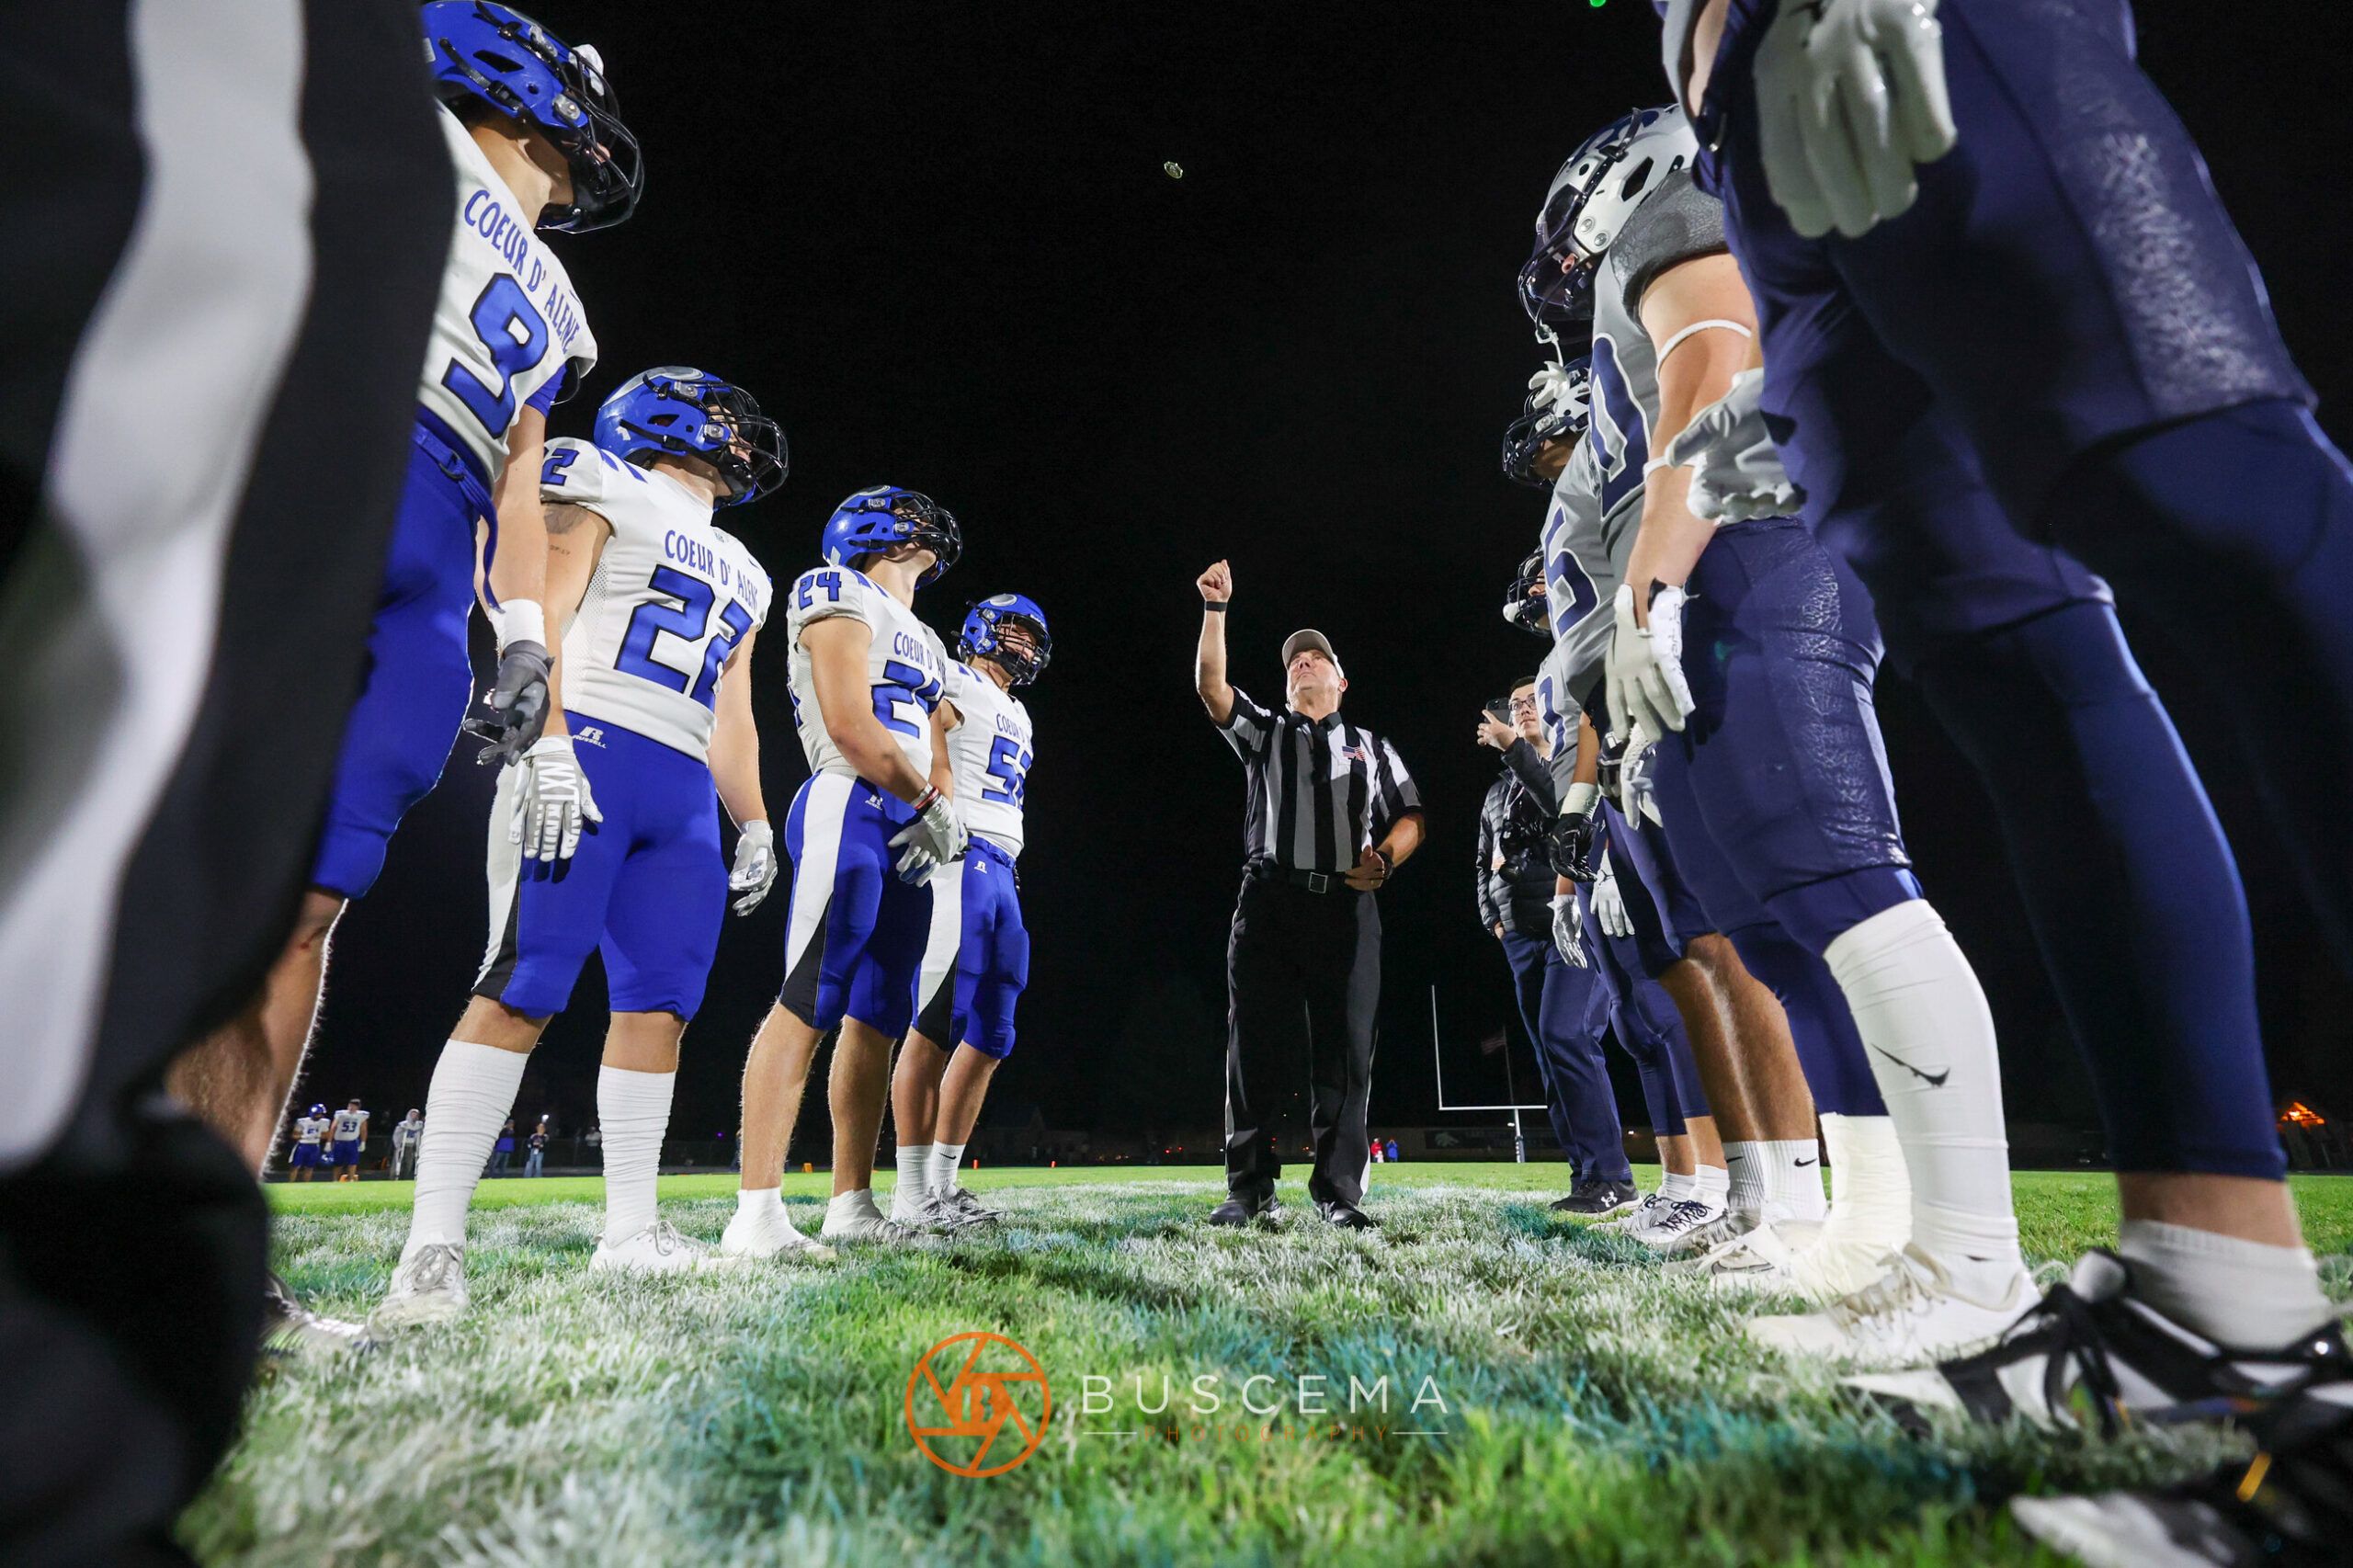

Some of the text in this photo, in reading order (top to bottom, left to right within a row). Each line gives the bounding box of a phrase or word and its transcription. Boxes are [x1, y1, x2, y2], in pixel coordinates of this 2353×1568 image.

[464, 189, 529, 276] COEUR
[544, 283, 580, 355] ALENE
[540, 447, 581, 486] 2
[665, 529, 714, 578] COEUR
[798, 571, 842, 610] 24
[614, 563, 754, 713] 22
[894, 631, 925, 666] COEUR
[573, 734, 607, 749] RUSSELL
[341, 1121, 358, 1132] 53
